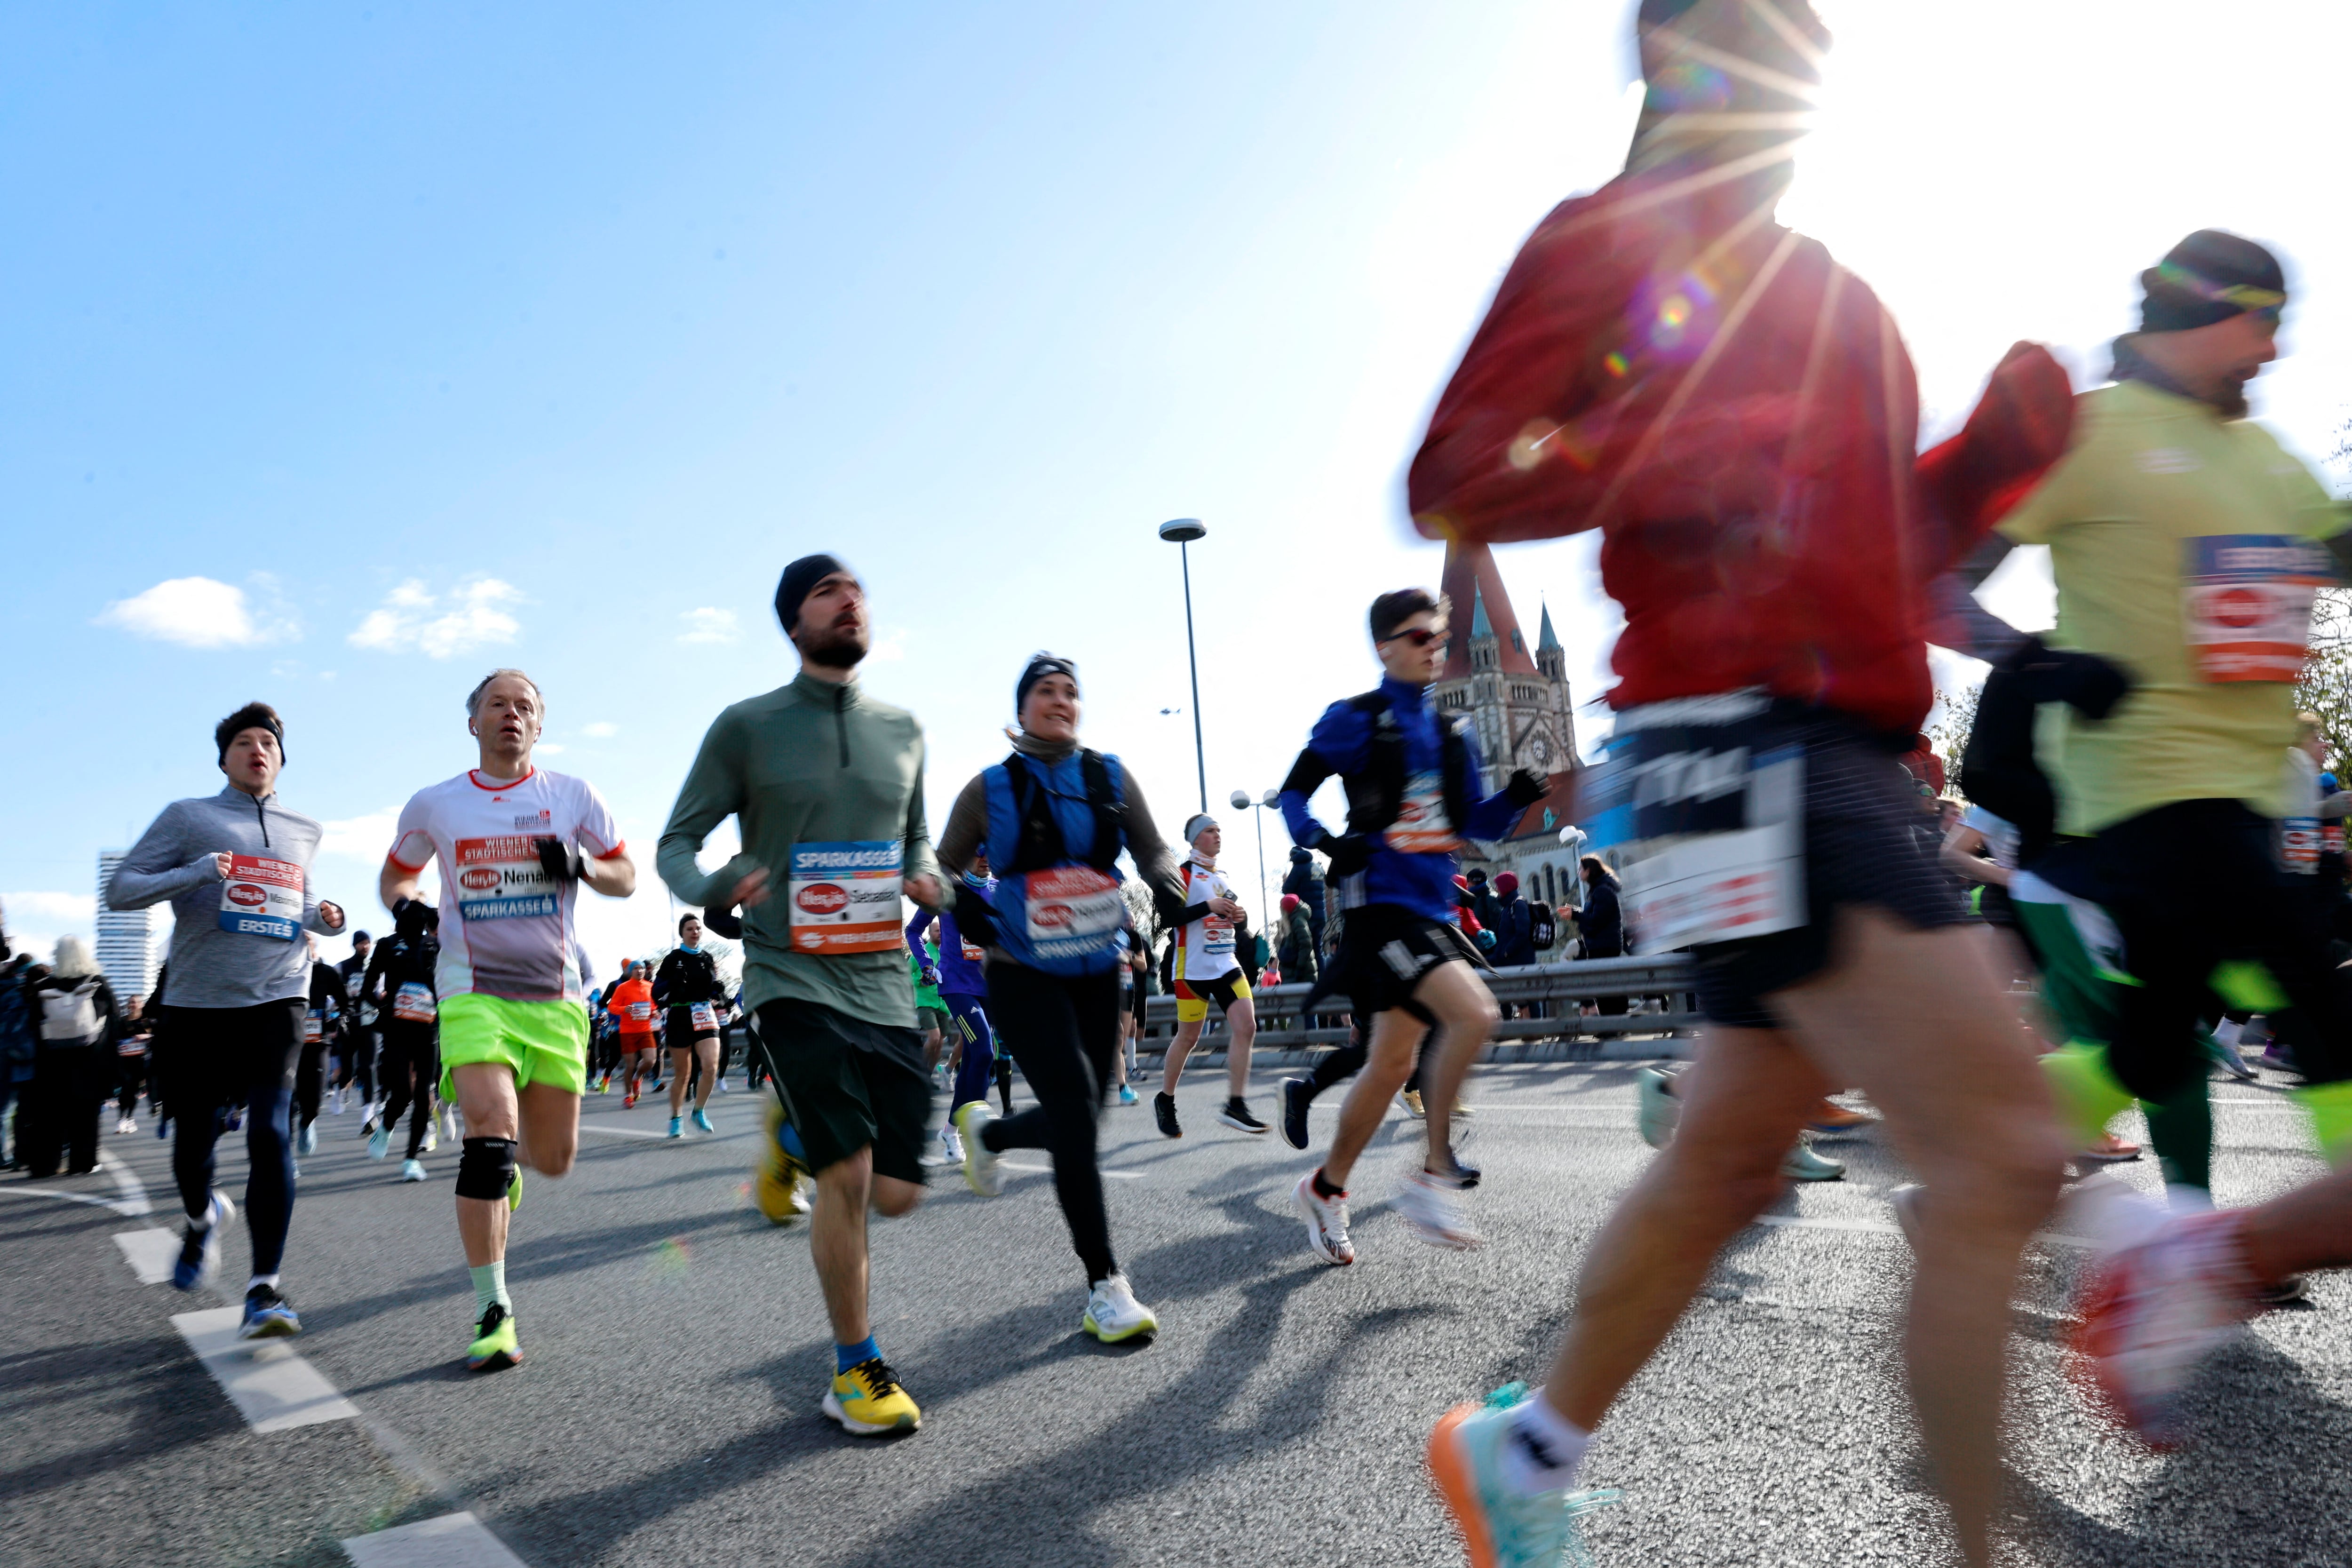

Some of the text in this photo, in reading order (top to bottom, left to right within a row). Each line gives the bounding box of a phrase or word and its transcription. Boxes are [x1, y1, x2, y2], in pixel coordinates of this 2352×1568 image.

[485, 836, 527, 847] WIENER
[464, 845, 528, 860] STÄDTISCHE
[796, 850, 888, 868] SPARKASSE
[258, 859, 294, 873] WIENER
[464, 871, 499, 887] Hervis
[464, 899, 540, 919] SPARKASSE
[238, 919, 281, 935] ERSTE
